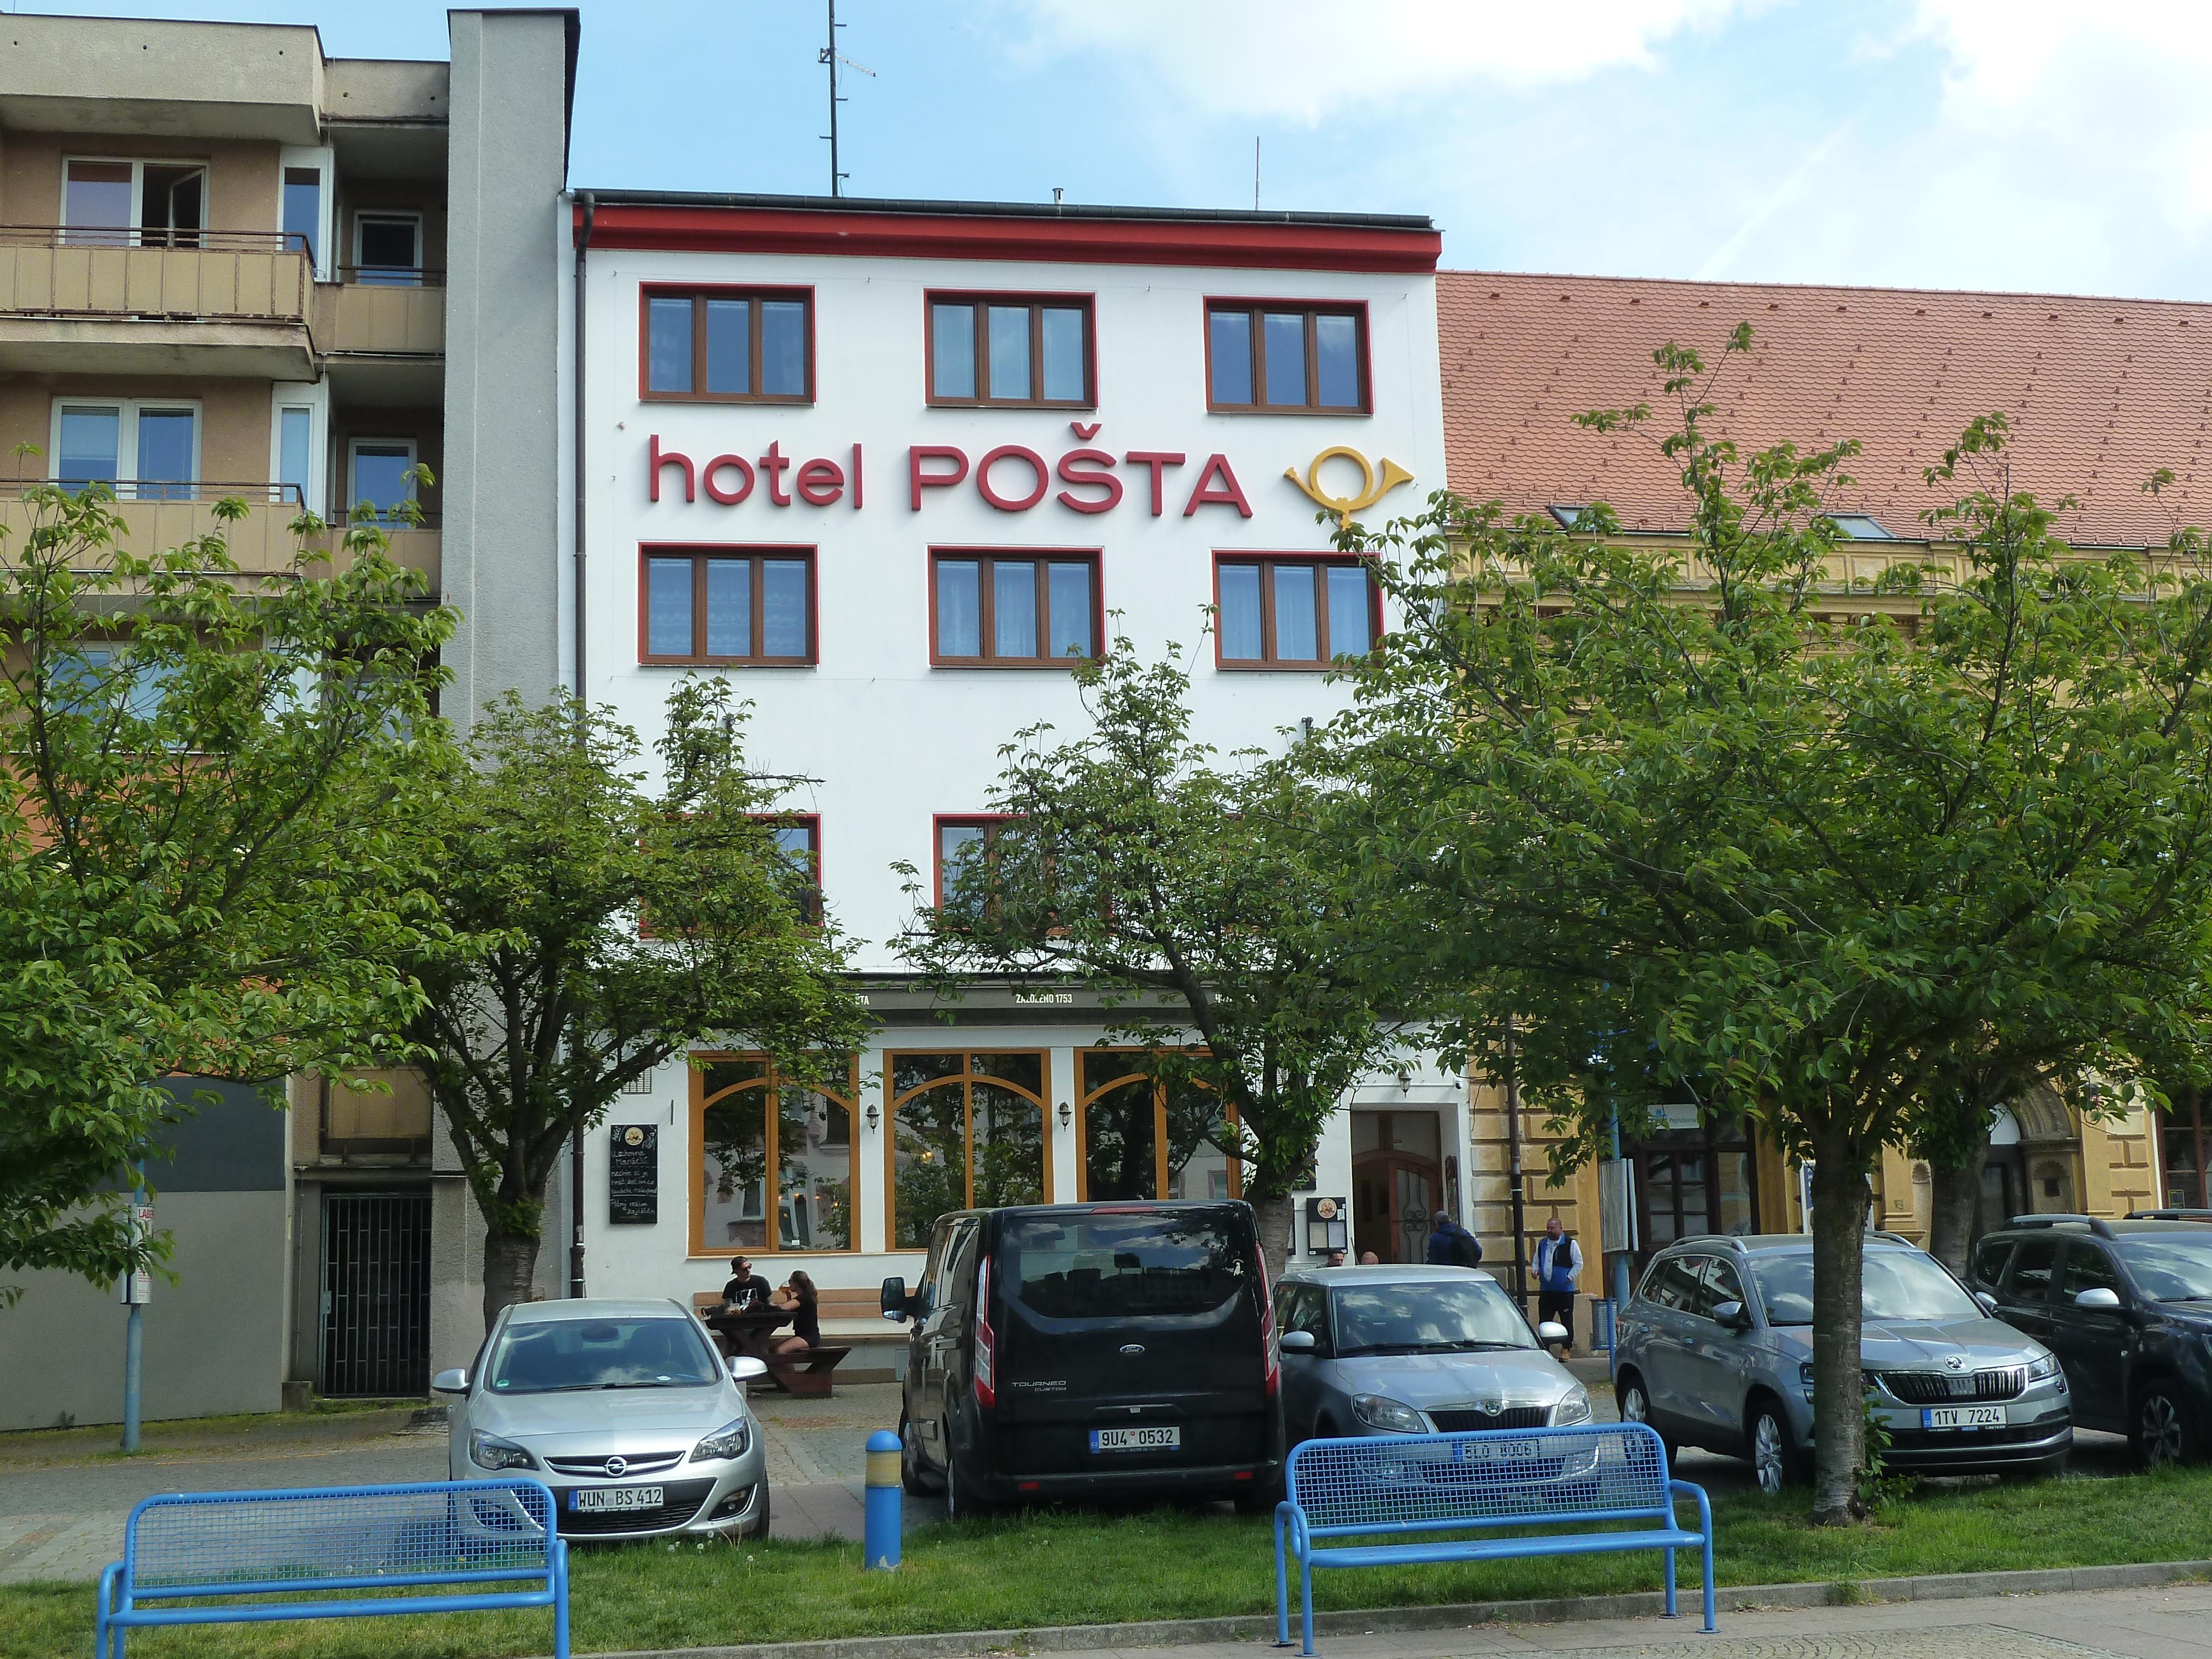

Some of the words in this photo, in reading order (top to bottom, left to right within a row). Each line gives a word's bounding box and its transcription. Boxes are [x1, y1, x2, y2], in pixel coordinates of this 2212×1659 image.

[649, 434, 863, 509] hotel
[909, 421, 1253, 519] POŠTA
[1055, 994, 1072, 1003] 1753
[1935, 1410, 1958, 1425] 1TV
[1969, 1408, 2000, 1423] 7224
[1102, 1431, 1128, 1446] 9U4
[1139, 1430, 1173, 1444] 0532
[578, 1492, 605, 1507] WUN
[615, 1490, 633, 1505] BS
[637, 1489, 662, 1504] 412
